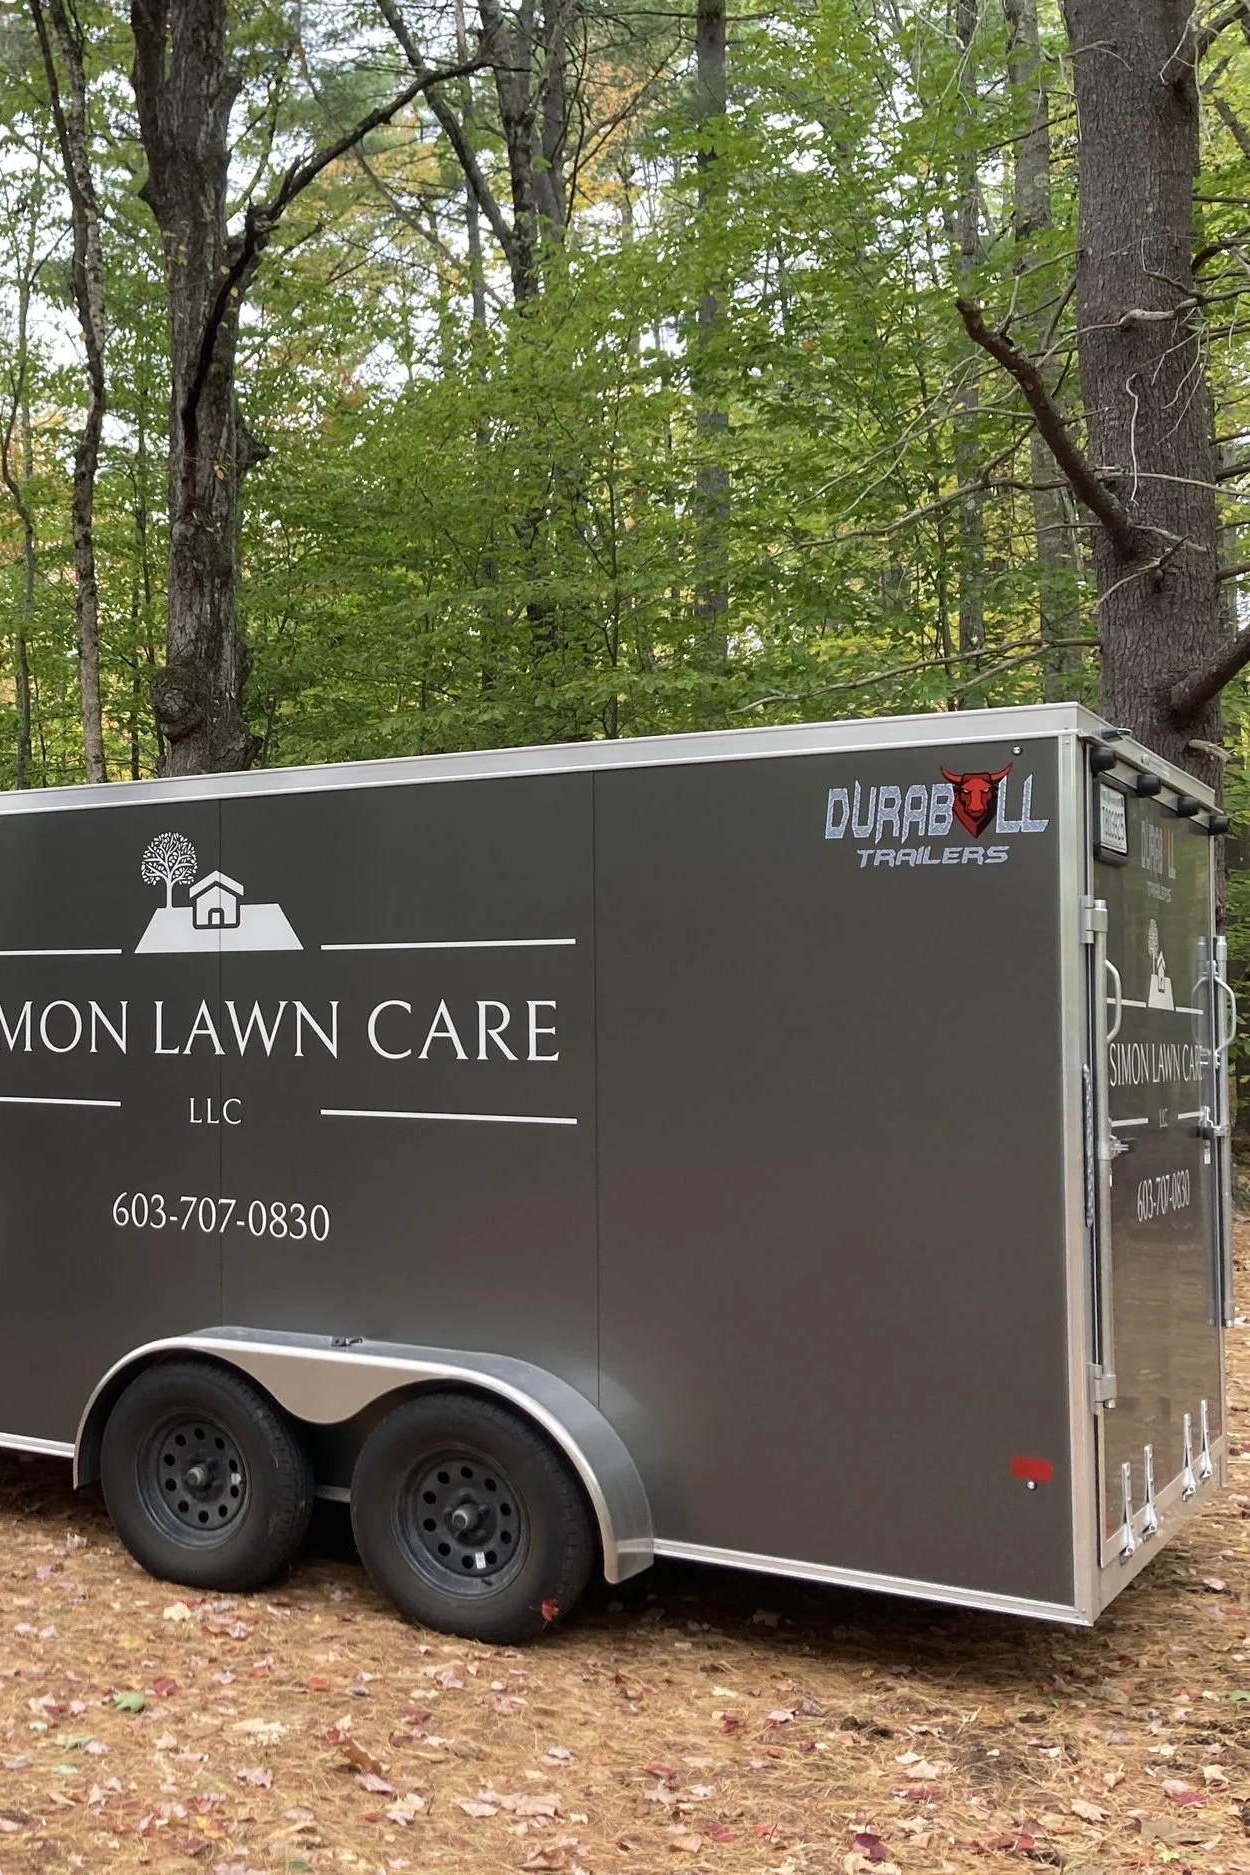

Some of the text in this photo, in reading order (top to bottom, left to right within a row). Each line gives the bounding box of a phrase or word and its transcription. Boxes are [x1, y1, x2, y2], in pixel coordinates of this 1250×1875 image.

[856, 845, 1010, 868] TRAILERS
[153, 998, 340, 1059] LAWN
[366, 998, 561, 1063] CARE
[1109, 1042, 1149, 1087] SIMON
[1152, 1042, 1181, 1083] LAWN
[189, 1097, 242, 1125] LLC
[111, 1192, 331, 1242] 603-707-0830
[1137, 1168, 1191, 1222] 603-707-0830
